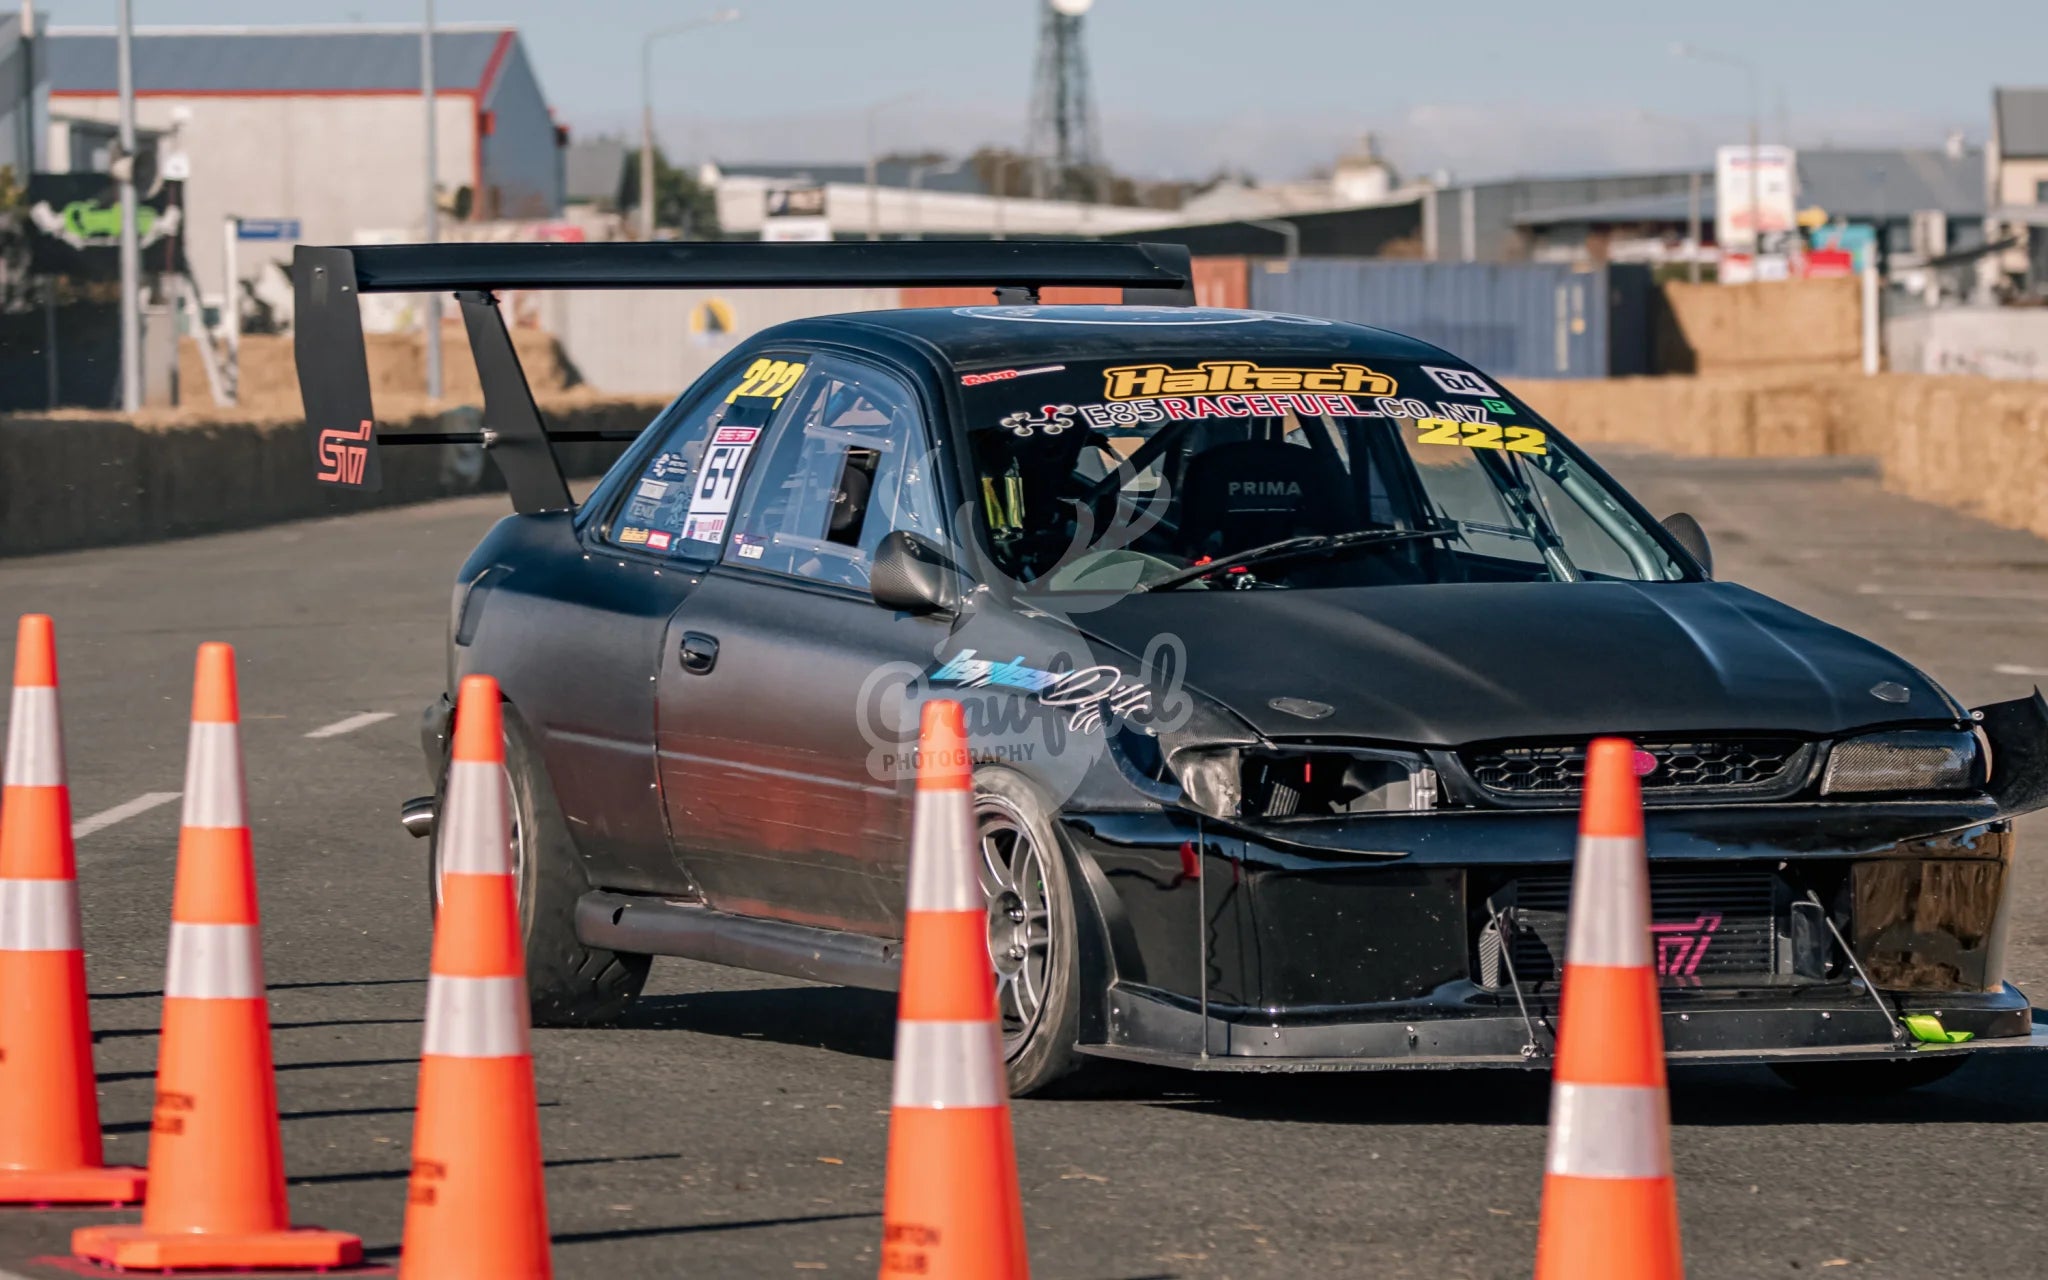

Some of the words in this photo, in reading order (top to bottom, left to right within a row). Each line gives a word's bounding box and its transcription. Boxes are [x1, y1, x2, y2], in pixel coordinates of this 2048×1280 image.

[724, 358, 806, 410] 222
[1105, 362, 1397, 400] Haltech
[1434, 371, 1487, 392] 64
[1417, 418, 1547, 455] 222
[701, 448, 746, 500] 64
[1228, 481, 1302, 496] PRIMA
